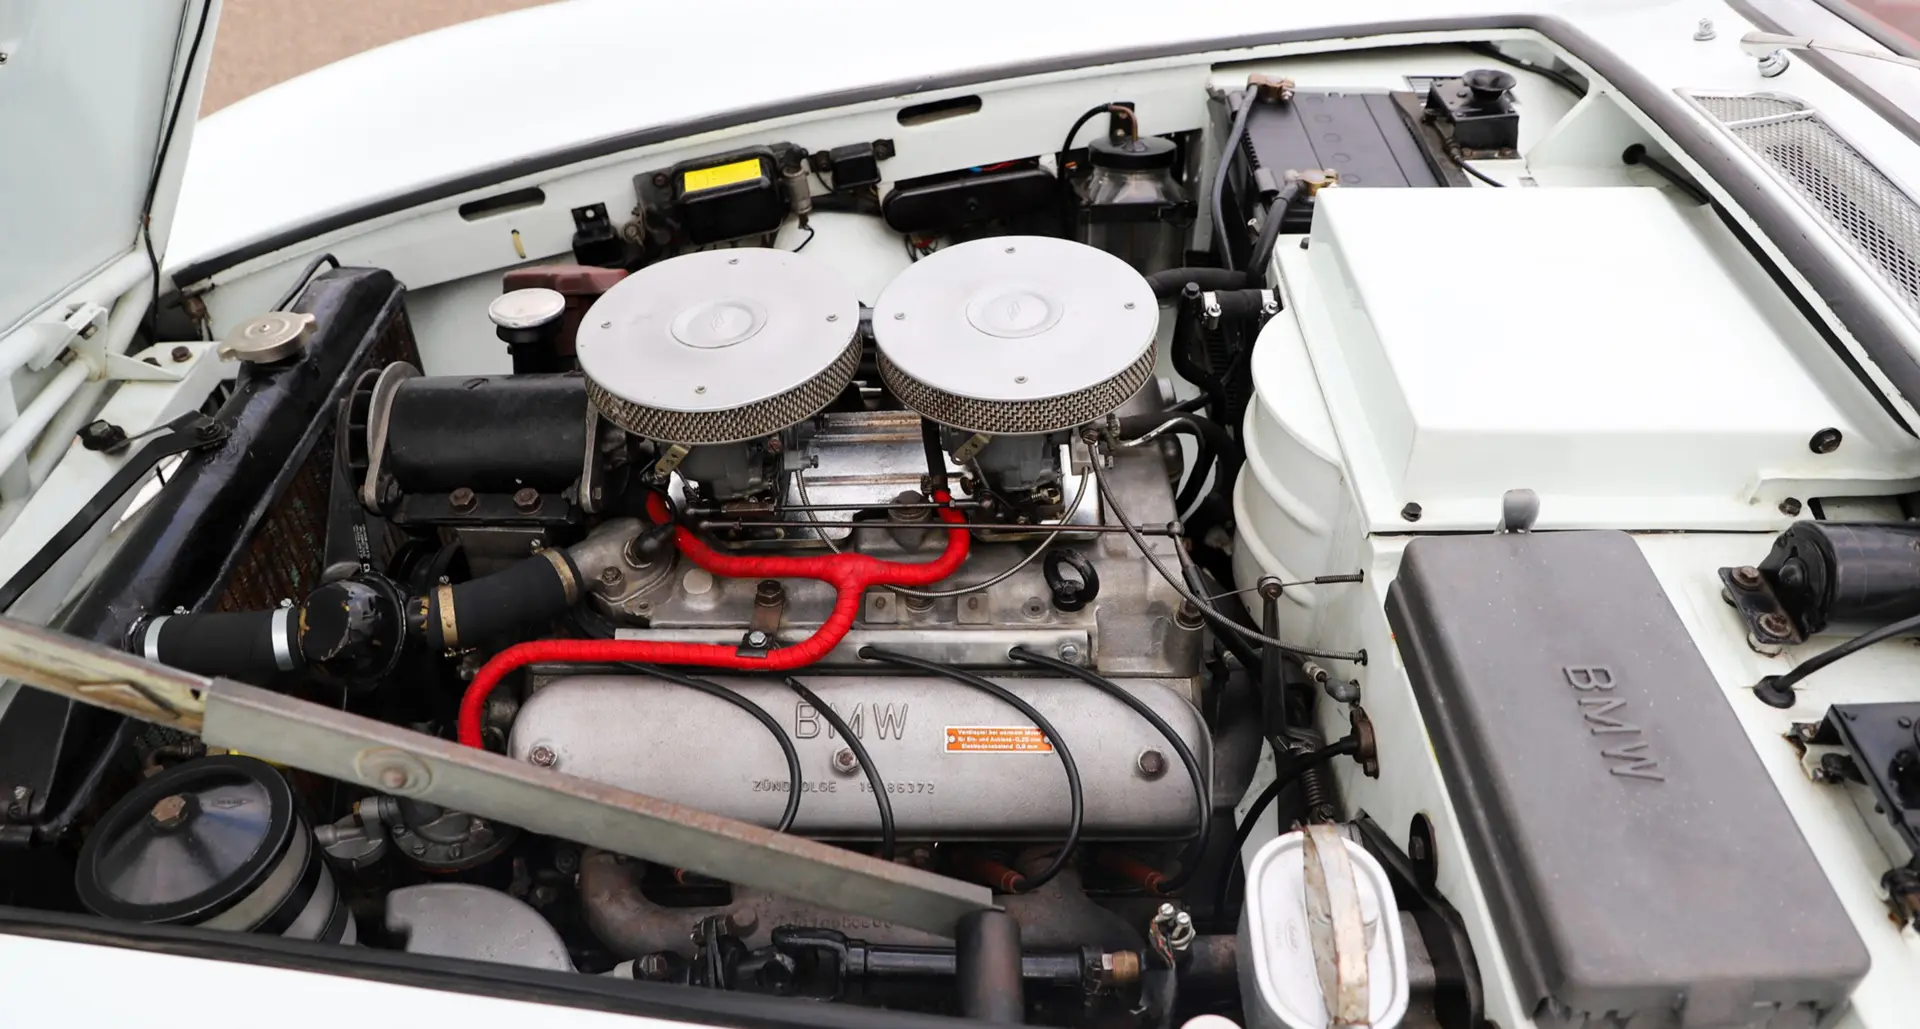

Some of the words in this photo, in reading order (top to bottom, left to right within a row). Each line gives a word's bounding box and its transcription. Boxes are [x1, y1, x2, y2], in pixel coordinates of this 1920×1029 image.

[795, 701, 909, 740] BMW
[1562, 665, 1665, 782] BMW
[752, 779, 837, 792] ZÜNDOLGE
